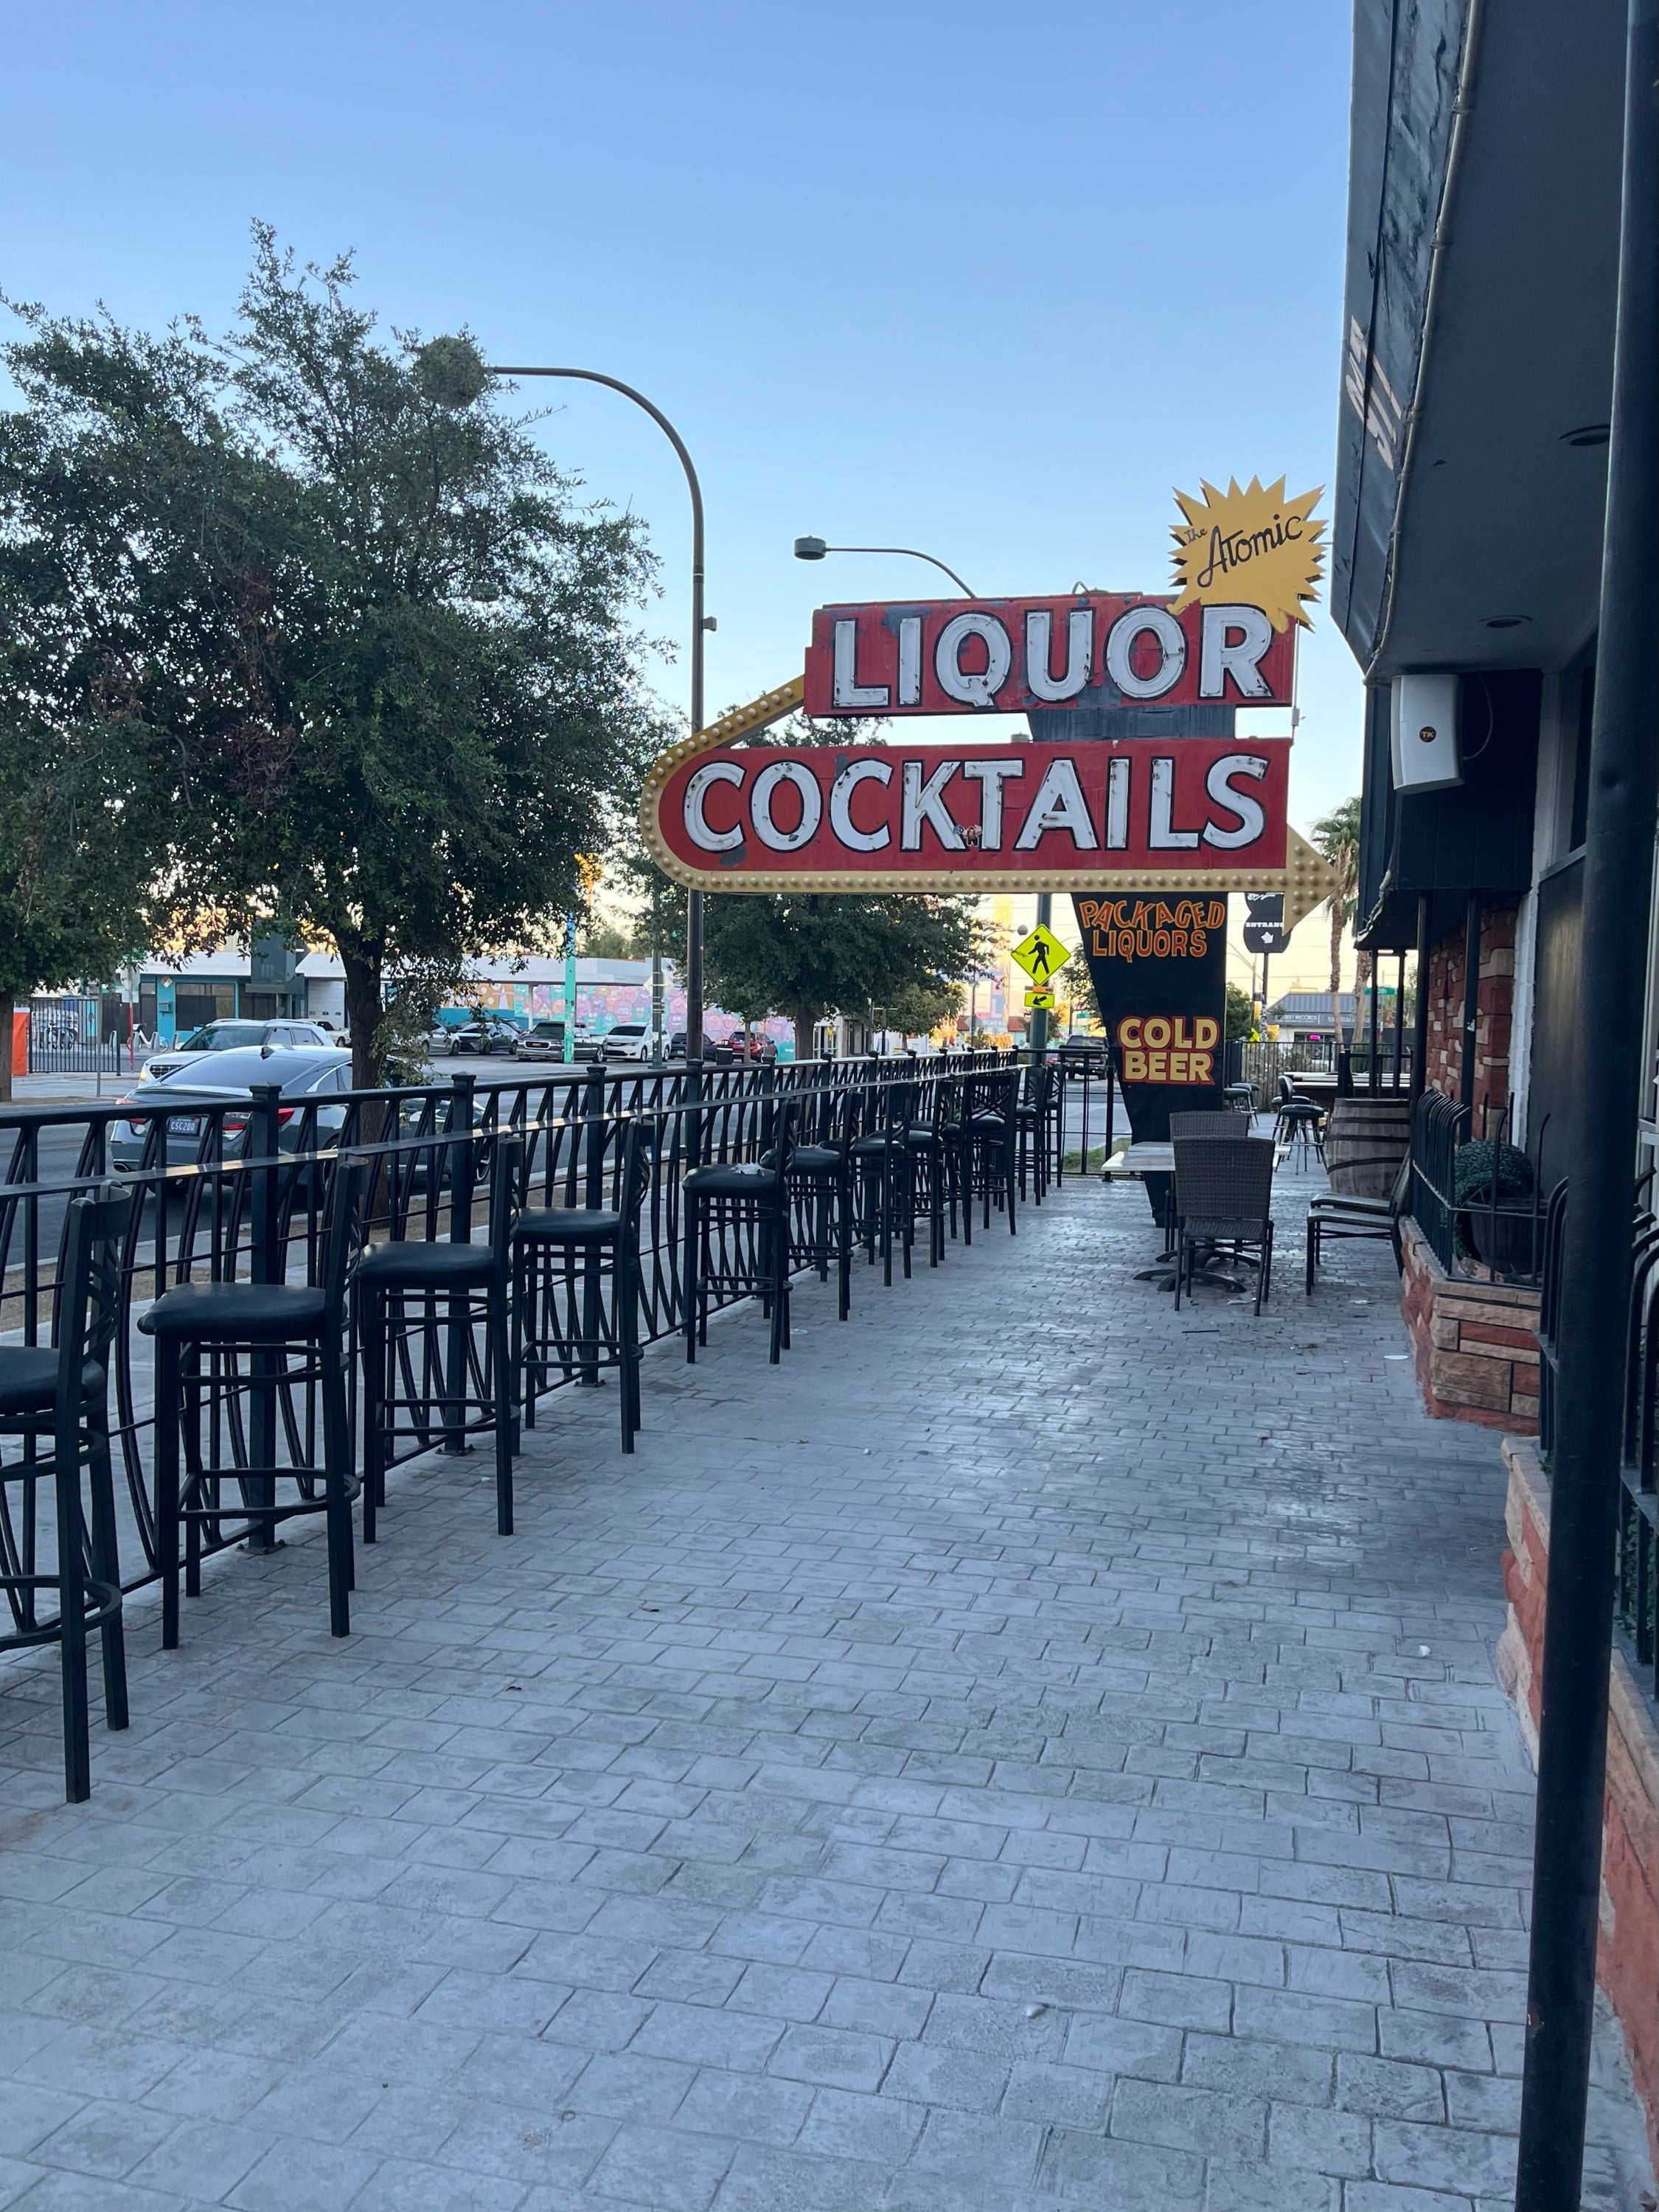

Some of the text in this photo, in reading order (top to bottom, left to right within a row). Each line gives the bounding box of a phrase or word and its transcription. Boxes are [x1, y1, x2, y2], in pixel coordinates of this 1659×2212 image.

[1184, 514, 1303, 587] The Atomic
[833, 606, 1273, 707] LIQUOR
[683, 755, 1269, 852] COCKTAILS
[1079, 900, 1225, 933] PACKAGED
[1093, 929, 1208, 963] LIQUORS
[1118, 1017, 1219, 1049] COLD
[1124, 1051, 1214, 1084] BEER
